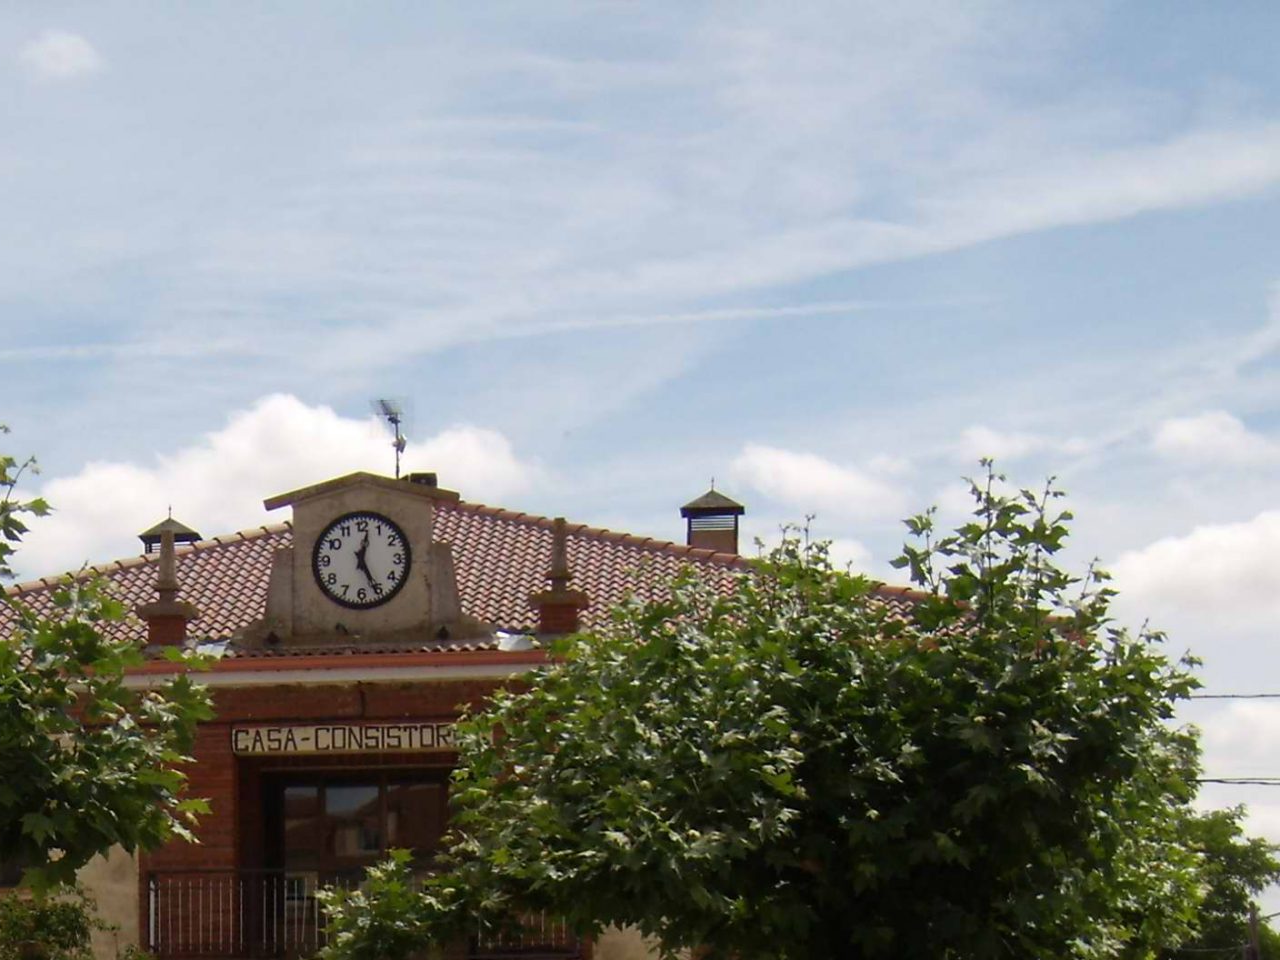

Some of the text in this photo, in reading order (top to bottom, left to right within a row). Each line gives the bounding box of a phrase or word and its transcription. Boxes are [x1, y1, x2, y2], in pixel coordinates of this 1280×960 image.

[340, 526, 351, 537] 11
[356, 520, 368, 532] 12
[376, 525, 381, 536] 1
[328, 538, 342, 550] 10
[387, 534, 396, 546] 2
[321, 555, 331, 567] 9
[393, 553, 402, 565] 3
[328, 573, 337, 585] 8
[387, 570, 396, 581] 4
[341, 585, 349, 596] 7
[357, 588, 367, 601] 6
[233, 724, 472, 752] CASA-CONSISTOR
